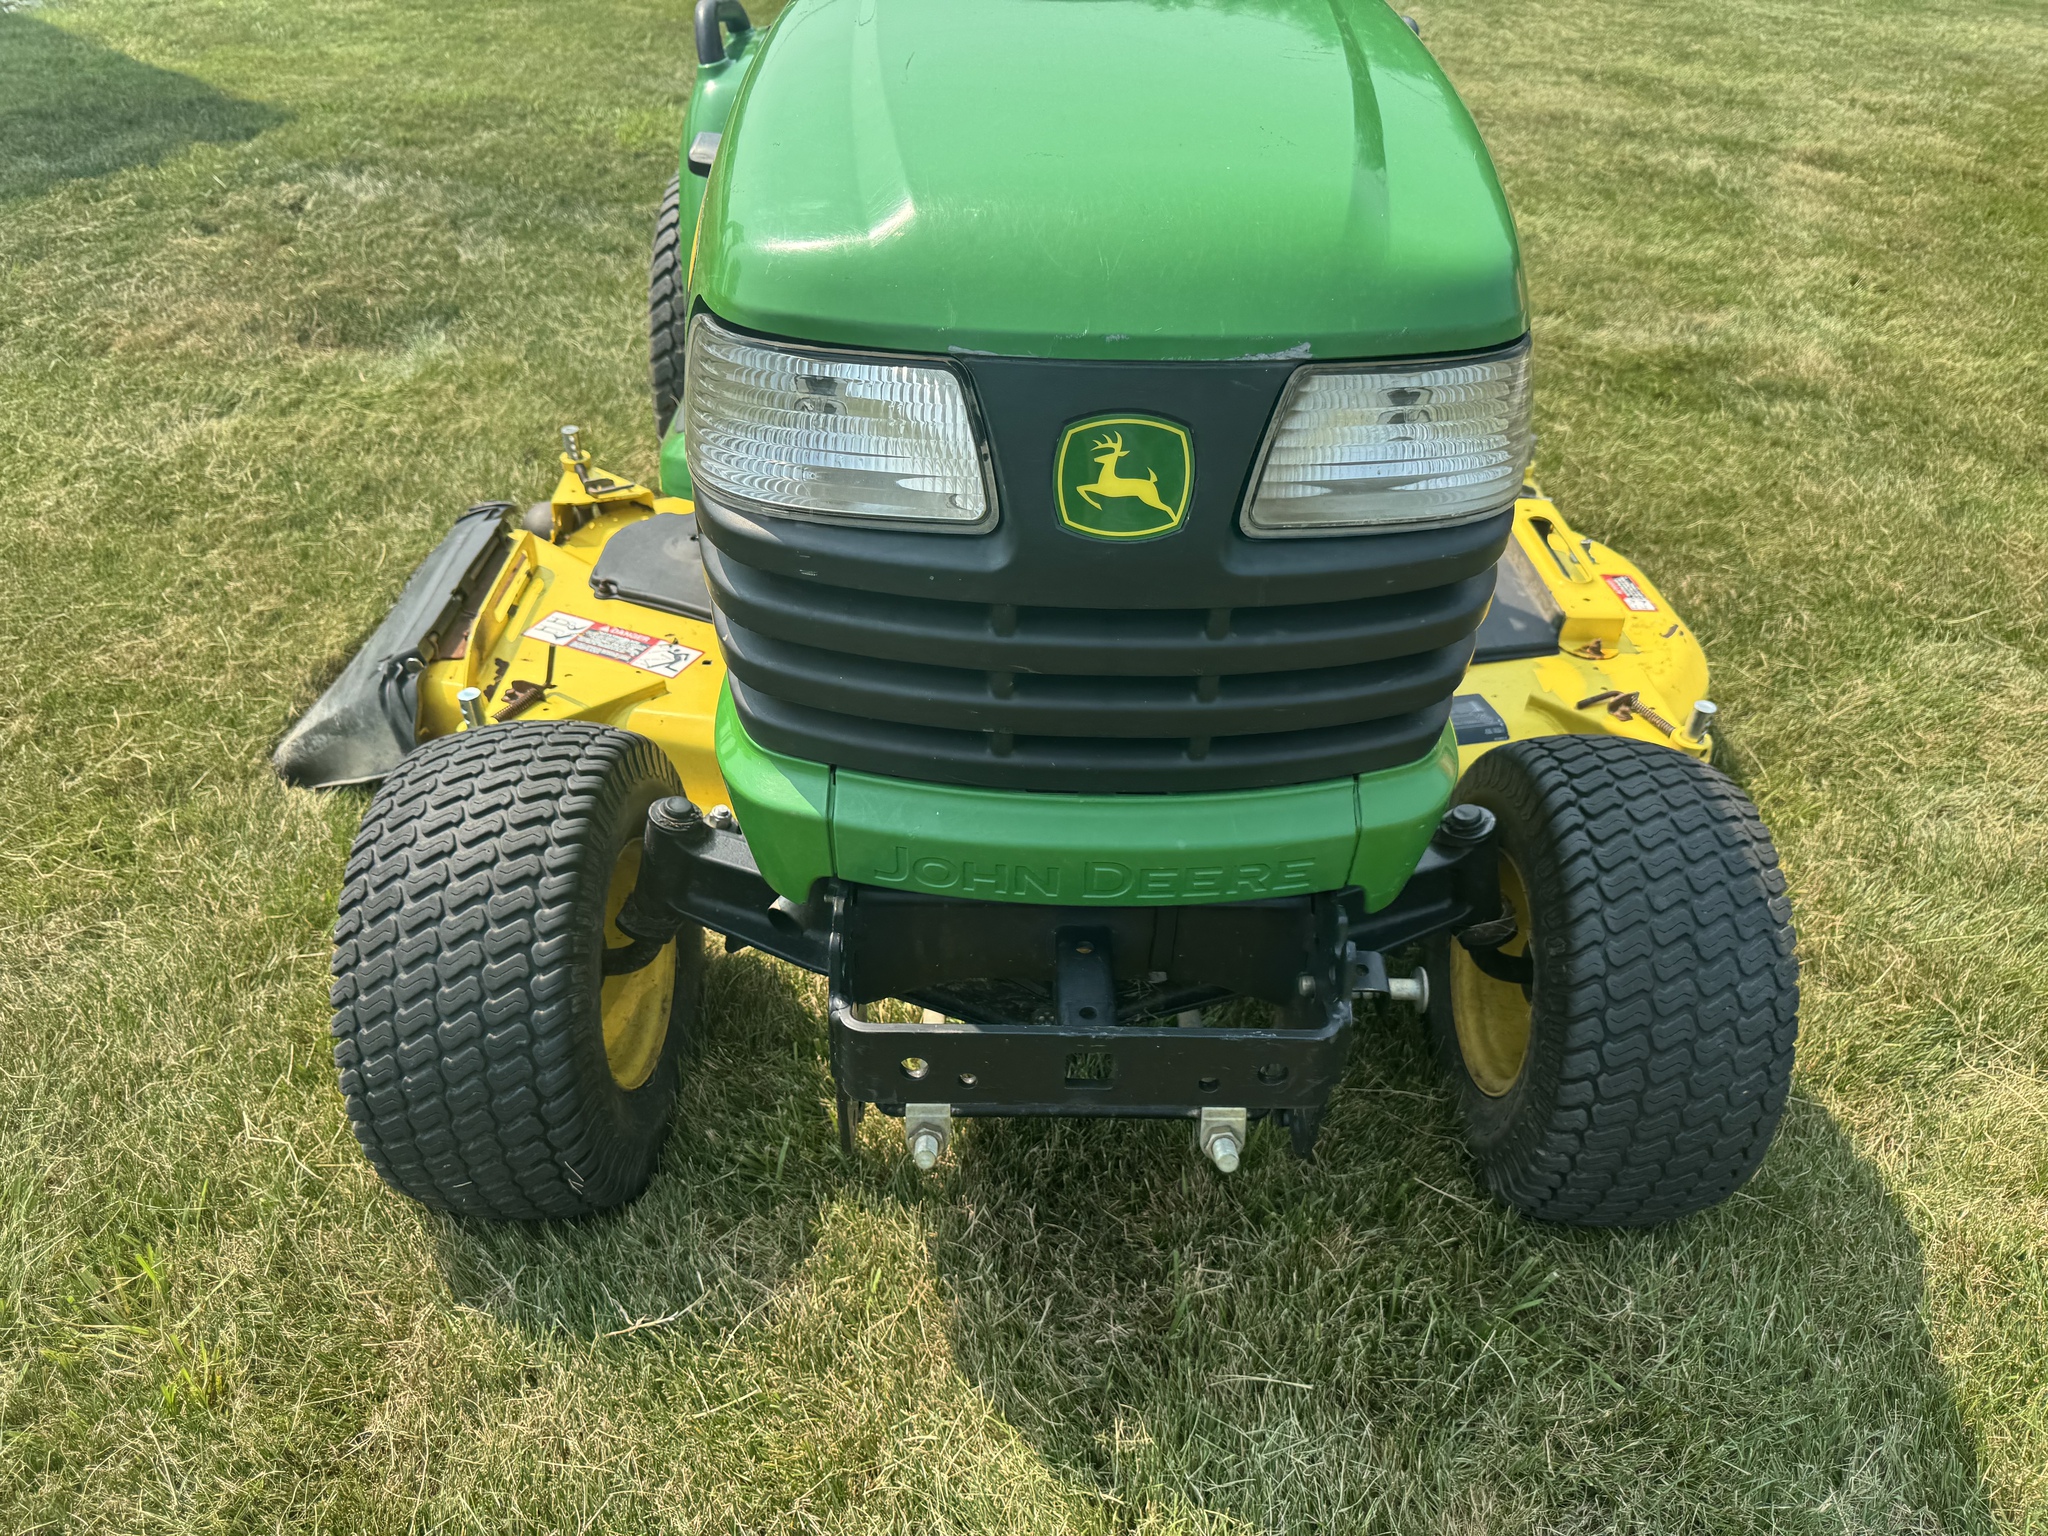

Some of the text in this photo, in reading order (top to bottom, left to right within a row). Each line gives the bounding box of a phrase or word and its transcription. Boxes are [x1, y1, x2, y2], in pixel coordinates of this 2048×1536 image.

[610, 627, 651, 643] DANGER
[874, 846, 1316, 899] JOHN DEERE
